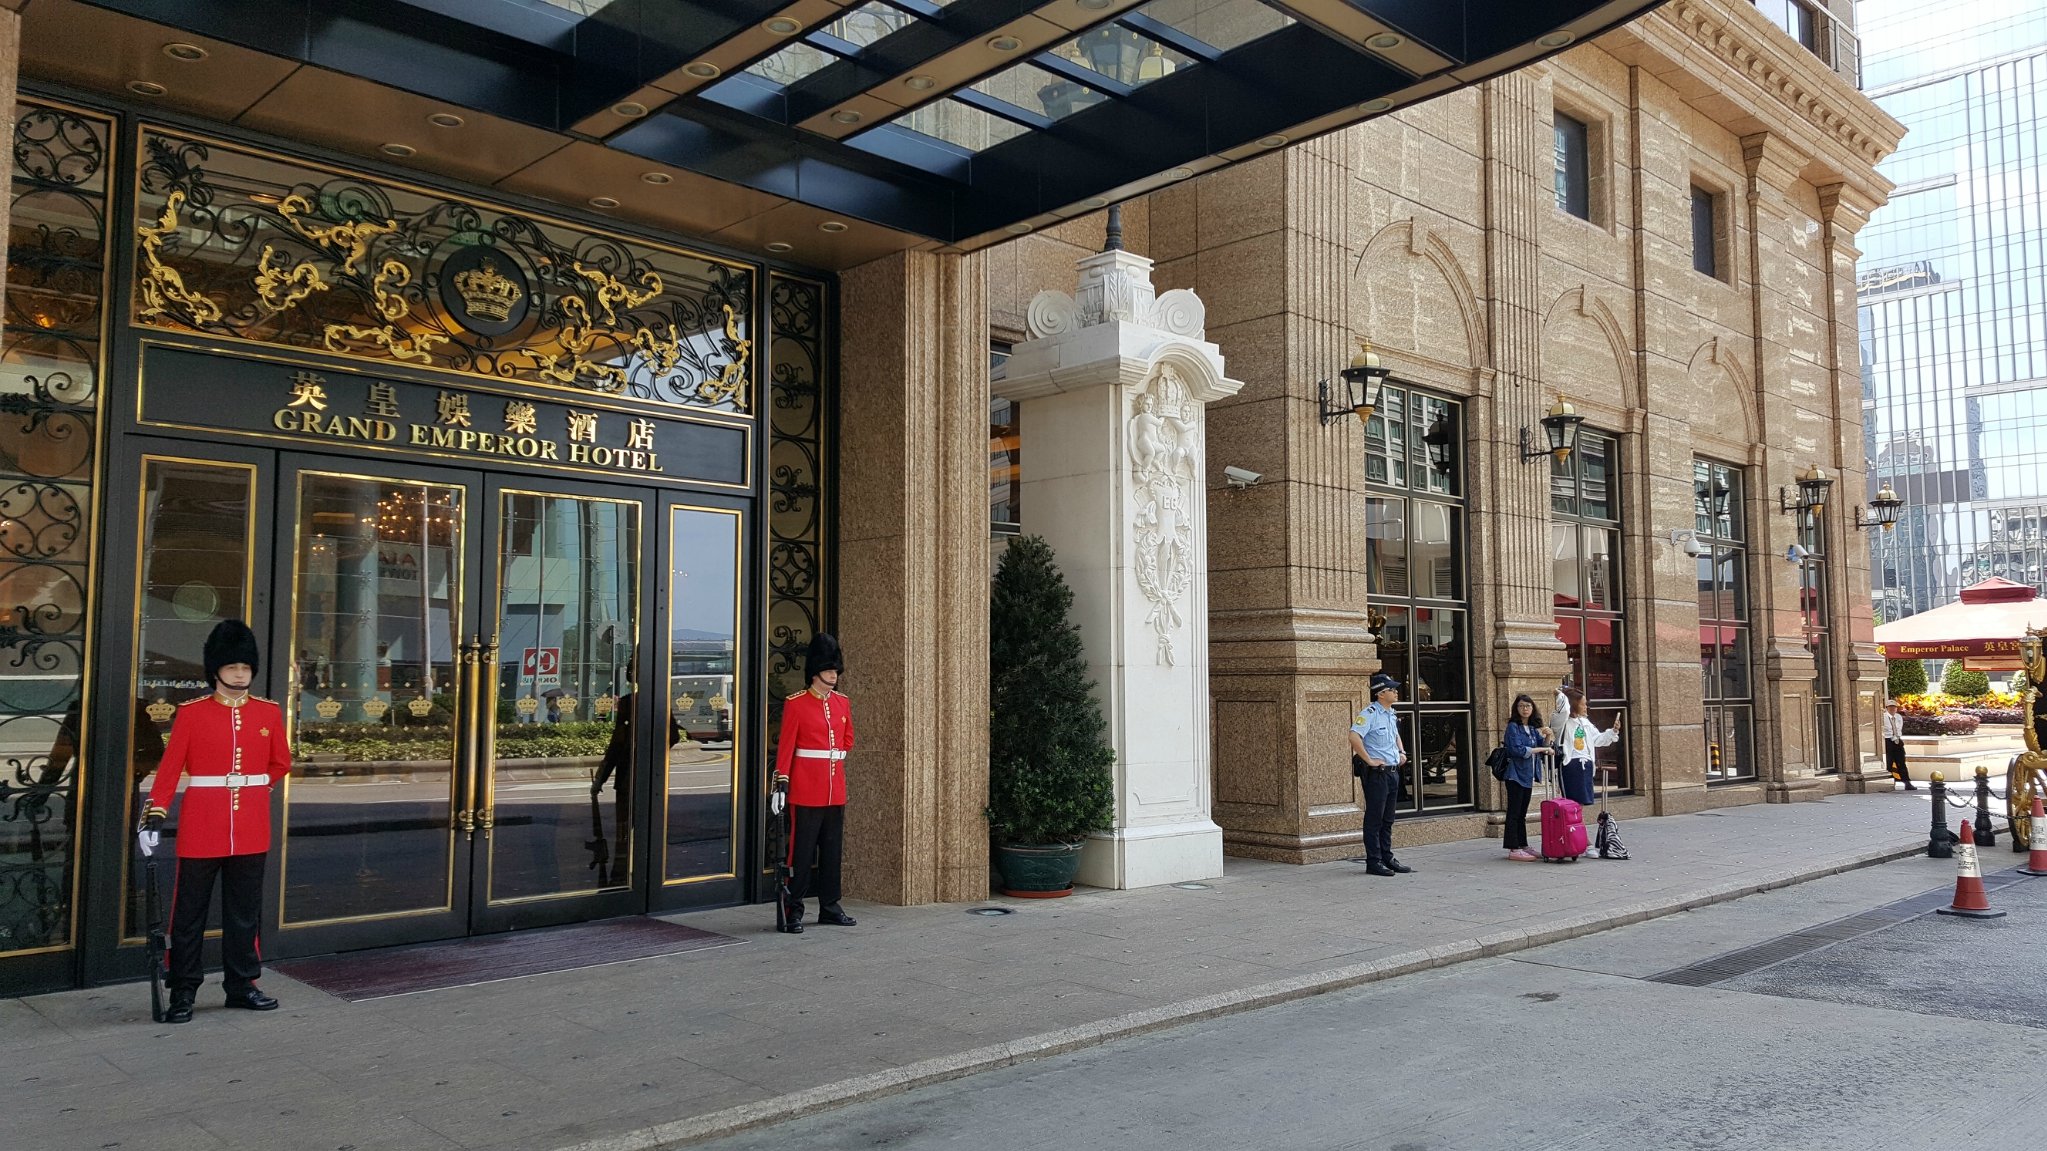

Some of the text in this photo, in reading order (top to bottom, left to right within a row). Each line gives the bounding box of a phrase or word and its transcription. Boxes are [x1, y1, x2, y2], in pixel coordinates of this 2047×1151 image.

[274, 409, 663, 472] GRAND EMPEROR HOTEL
[1900, 644, 1969, 655] Emperor Palace
